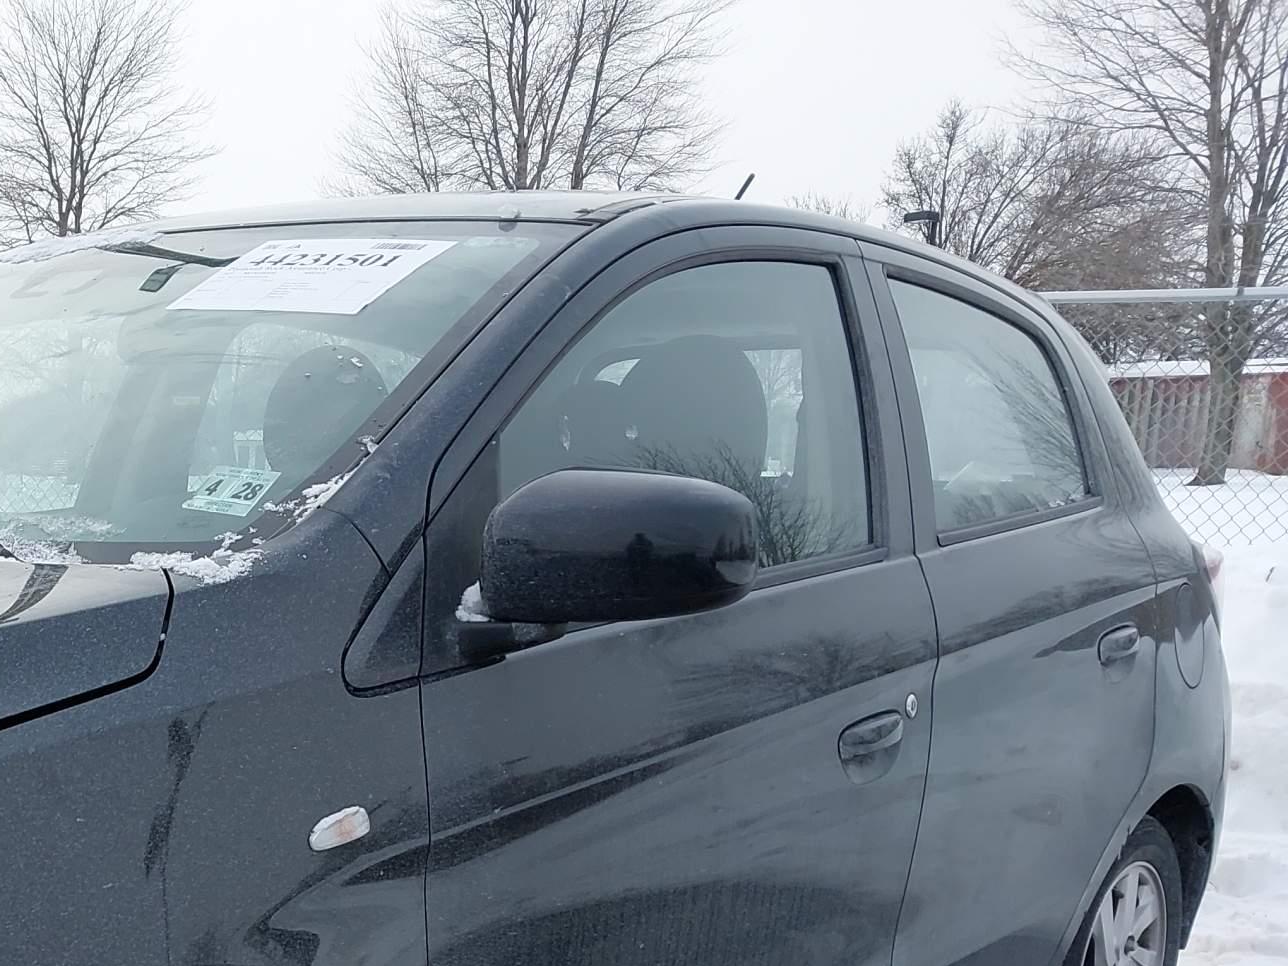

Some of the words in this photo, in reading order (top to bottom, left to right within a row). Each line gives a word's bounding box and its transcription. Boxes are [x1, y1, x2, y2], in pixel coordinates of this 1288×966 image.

[249, 253, 402, 267] 44231501
[205, 479, 224, 496] 4
[231, 482, 264, 500] 28
